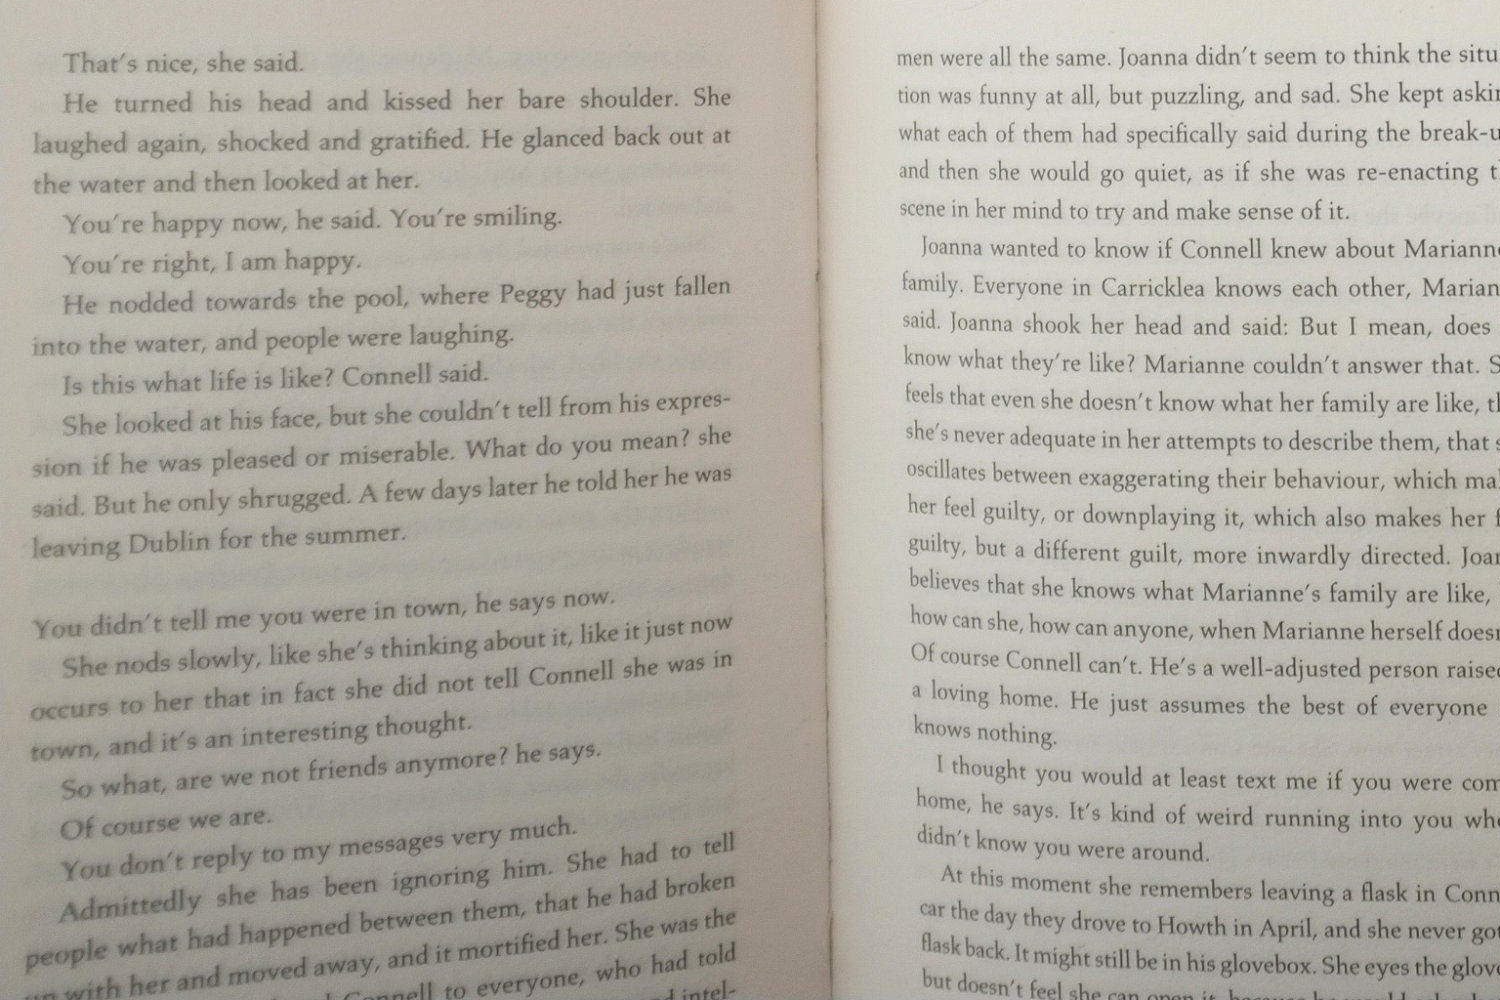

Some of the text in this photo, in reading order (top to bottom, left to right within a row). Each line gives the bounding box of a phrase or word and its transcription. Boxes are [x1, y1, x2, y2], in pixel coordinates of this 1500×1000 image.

[62, 49, 304, 75] That's nice, she said.
[64, 84, 732, 114] He turned his head and kissed her bare shoulder. She
[898, 120, 941, 143] what
[947, 121, 988, 143] each
[995, 121, 1016, 144] of
[1022, 121, 1073, 144] them
[1081, 121, 1118, 144] had
[1125, 121, 1239, 150] specifically
[1246, 120, 1288, 144] said
[1296, 120, 1369, 149] during
[1376, 120, 1411, 143] the
[63, 203, 563, 239] You're happy now, he said. You're smiling.
[921, 234, 983, 258] Joanna
[989, 236, 1060, 258] wanted
[1066, 242, 1087, 259] to
[1094, 236, 1150, 259] know
[1157, 236, 1174, 259] if
[1180, 236, 1263, 260] Connell
[1270, 236, 1328, 260] knew
[1335, 236, 1396, 260] about
[63, 273, 731, 315] He nodded towards the pool, where Peggy had just fallen
[902, 269, 964, 299] family.
[973, 274, 1064, 301] Everyone
[1072, 277, 1092, 297] in
[1101, 275, 1206, 298] Carricklea
[1214, 275, 1283, 298] knows
[1291, 275, 1339, 298] each
[1348, 275, 1412, 300] other,
[906, 457, 987, 482] oscillates
[992, 460, 1072, 486] between
[1078, 468, 1211, 495] exaggerating
[1216, 466, 1268, 489] their
[1273, 467, 1386, 493] behaviour,
[1393, 467, 1458, 490] which
[32, 525, 406, 561] leaving Dublin for the summer.
[32, 591, 615, 640] You didn't tell me you were in town, he says now.
[910, 641, 936, 663] Of
[939, 650, 1000, 668] course
[1005, 649, 1082, 673] Connell
[1088, 655, 1143, 675] can't.
[1150, 655, 1197, 677] He's
[1202, 662, 1214, 677] a
[1220, 655, 1362, 684] well-adjusted
[1368, 664, 1439, 685] person
[30, 710, 472, 762] town, and it's an interesting thought.
[58, 830, 735, 923] Admittedly she has been ignoring him. She had to tell
[940, 864, 964, 884] At
[970, 865, 1004, 888] this
[1010, 876, 1092, 895] moment
[1098, 874, 1132, 897] she
[1140, 878, 1253, 900] remembers
[1260, 878, 1336, 908] leaving
[1342, 888, 1353, 902] a
[1361, 880, 1408, 903] flask
[1415, 883, 1436, 903] in
